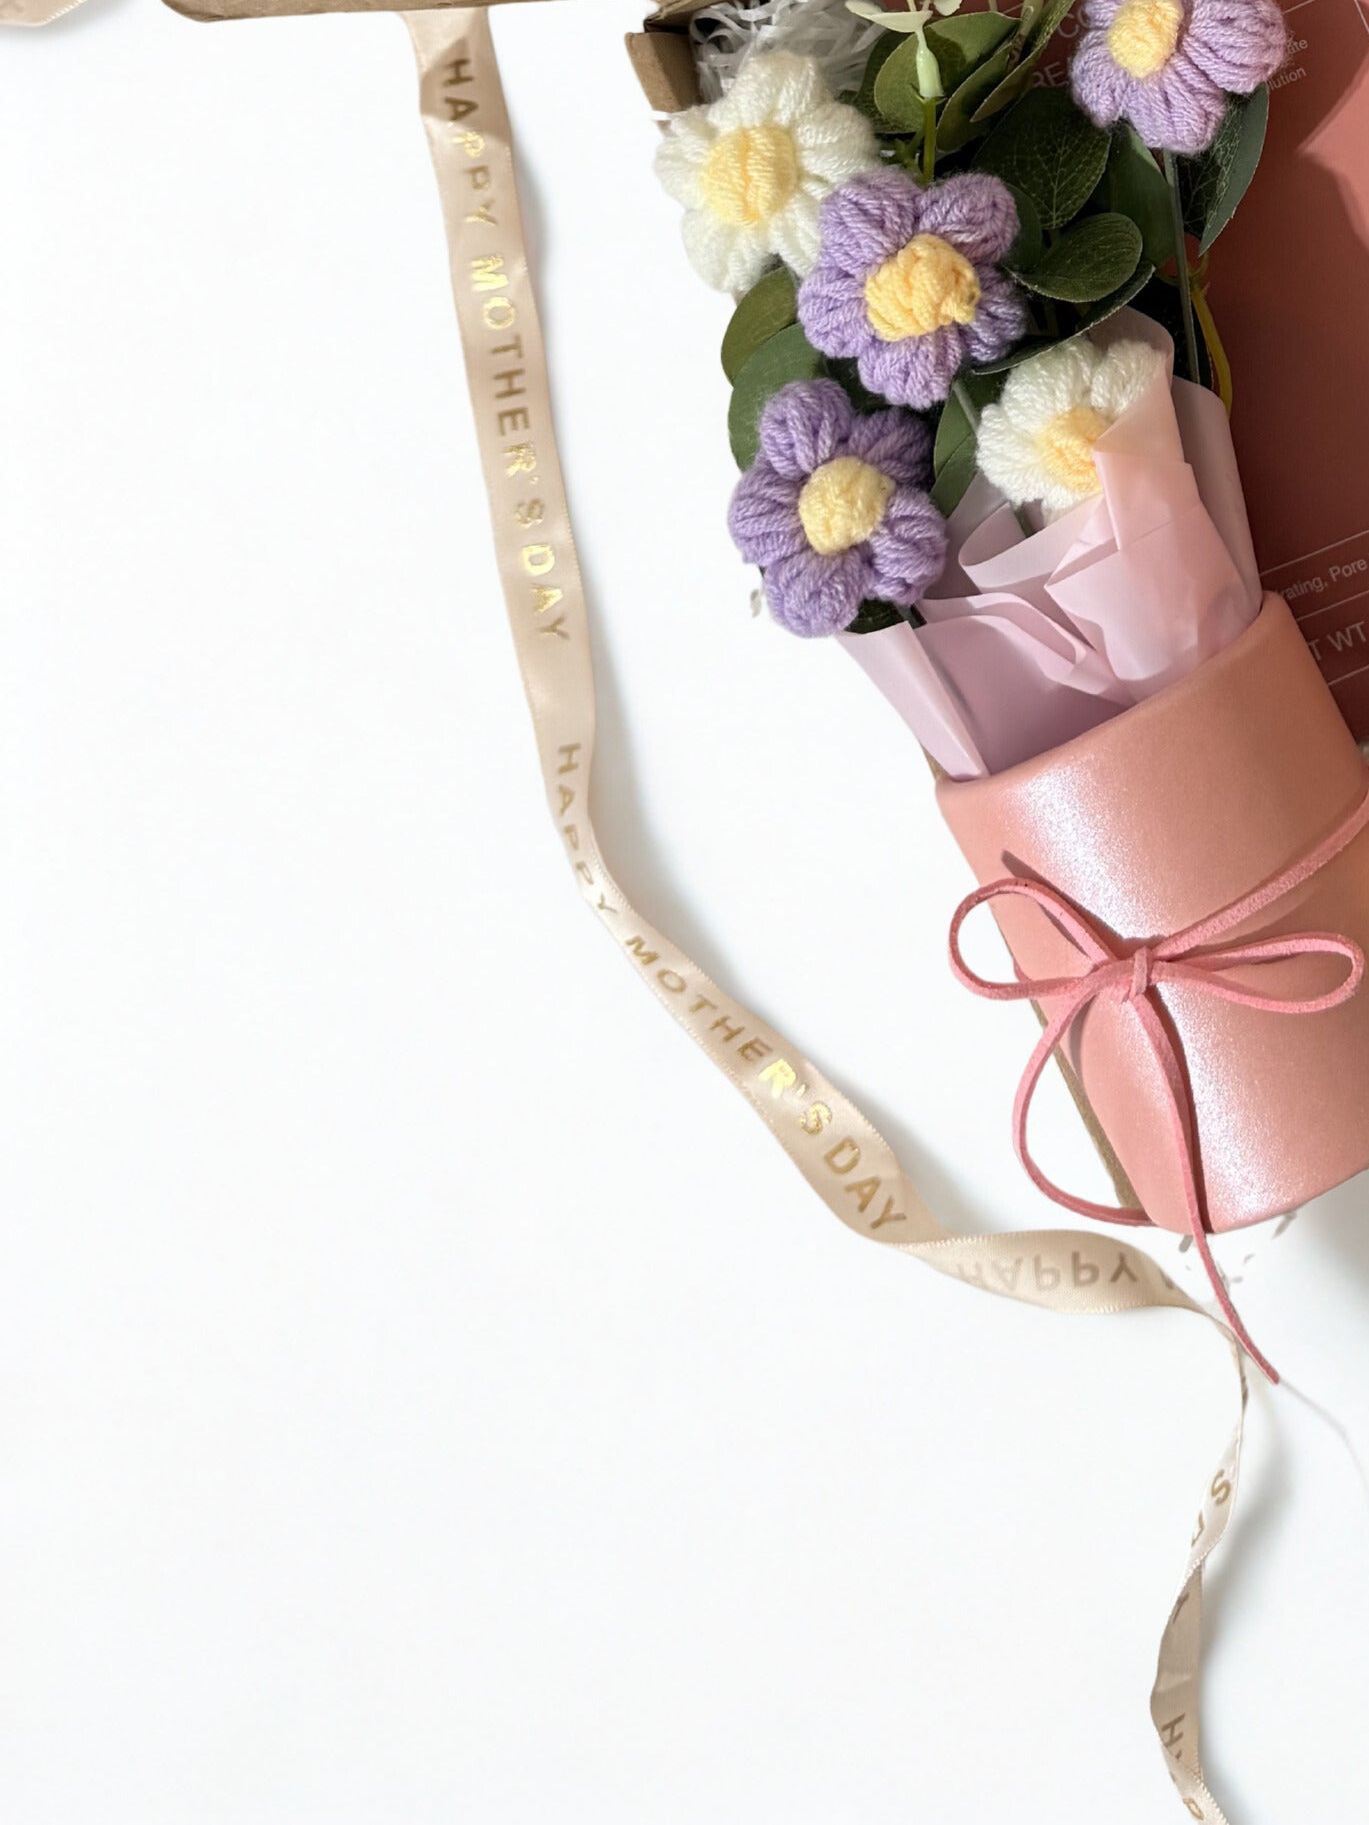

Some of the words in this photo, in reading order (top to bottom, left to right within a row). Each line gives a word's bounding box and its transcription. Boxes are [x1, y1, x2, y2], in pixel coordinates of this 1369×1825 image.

[442, 58, 498, 226] HAPPY
[471, 254, 545, 528] MOTHER'S
[521, 543, 570, 640] DAY
[1329, 558, 1368, 582] Pore
[557, 742, 617, 914] HAPPY
[626, 936, 832, 1135] MOTHER'S
[823, 1137, 907, 1229] DAY
